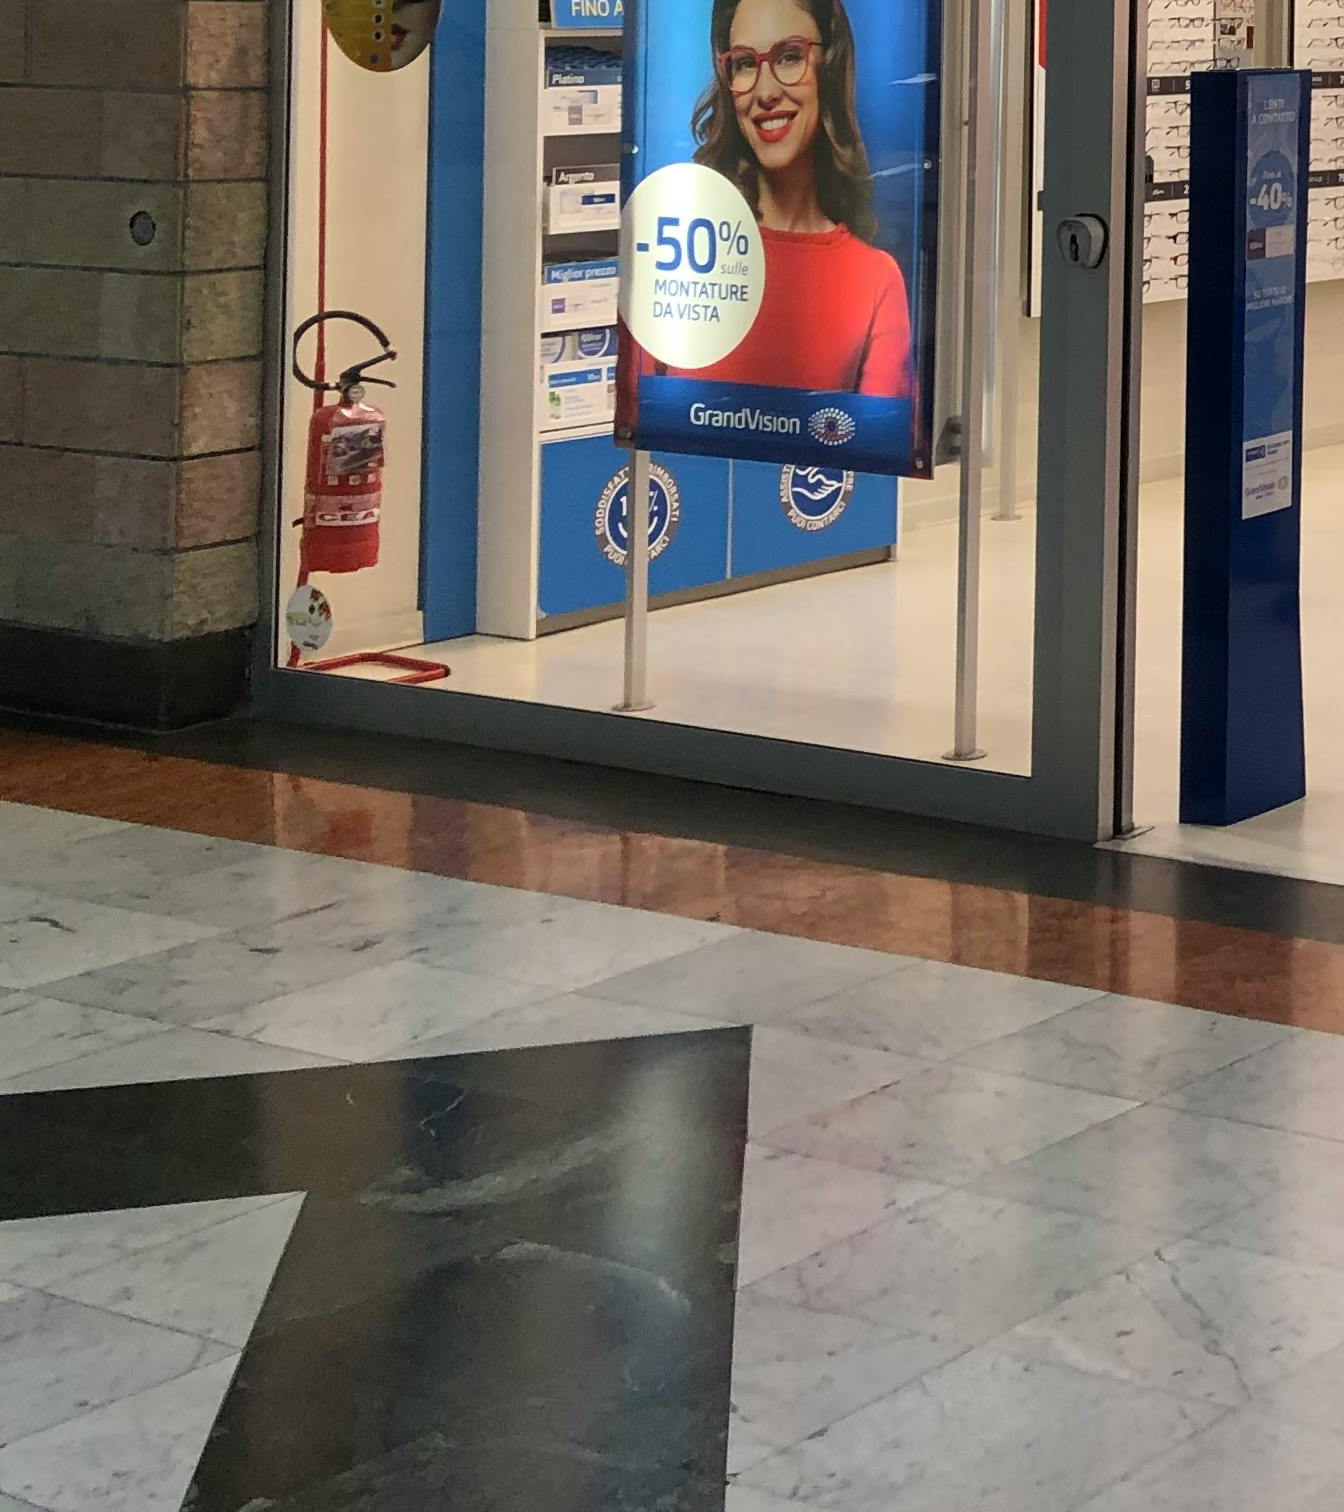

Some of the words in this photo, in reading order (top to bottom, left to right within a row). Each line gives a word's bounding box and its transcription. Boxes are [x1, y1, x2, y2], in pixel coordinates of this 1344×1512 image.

[1250, 181, 1293, 212] -40%
[636, 216, 750, 275] -50%
[719, 262, 749, 277] sulle
[653, 278, 749, 303] MONTATURE
[652, 301, 674, 320] DA
[676, 303, 721, 323] VISTA
[689, 402, 801, 435] GrandVision
[595, 466, 629, 536] SODDISFAT
